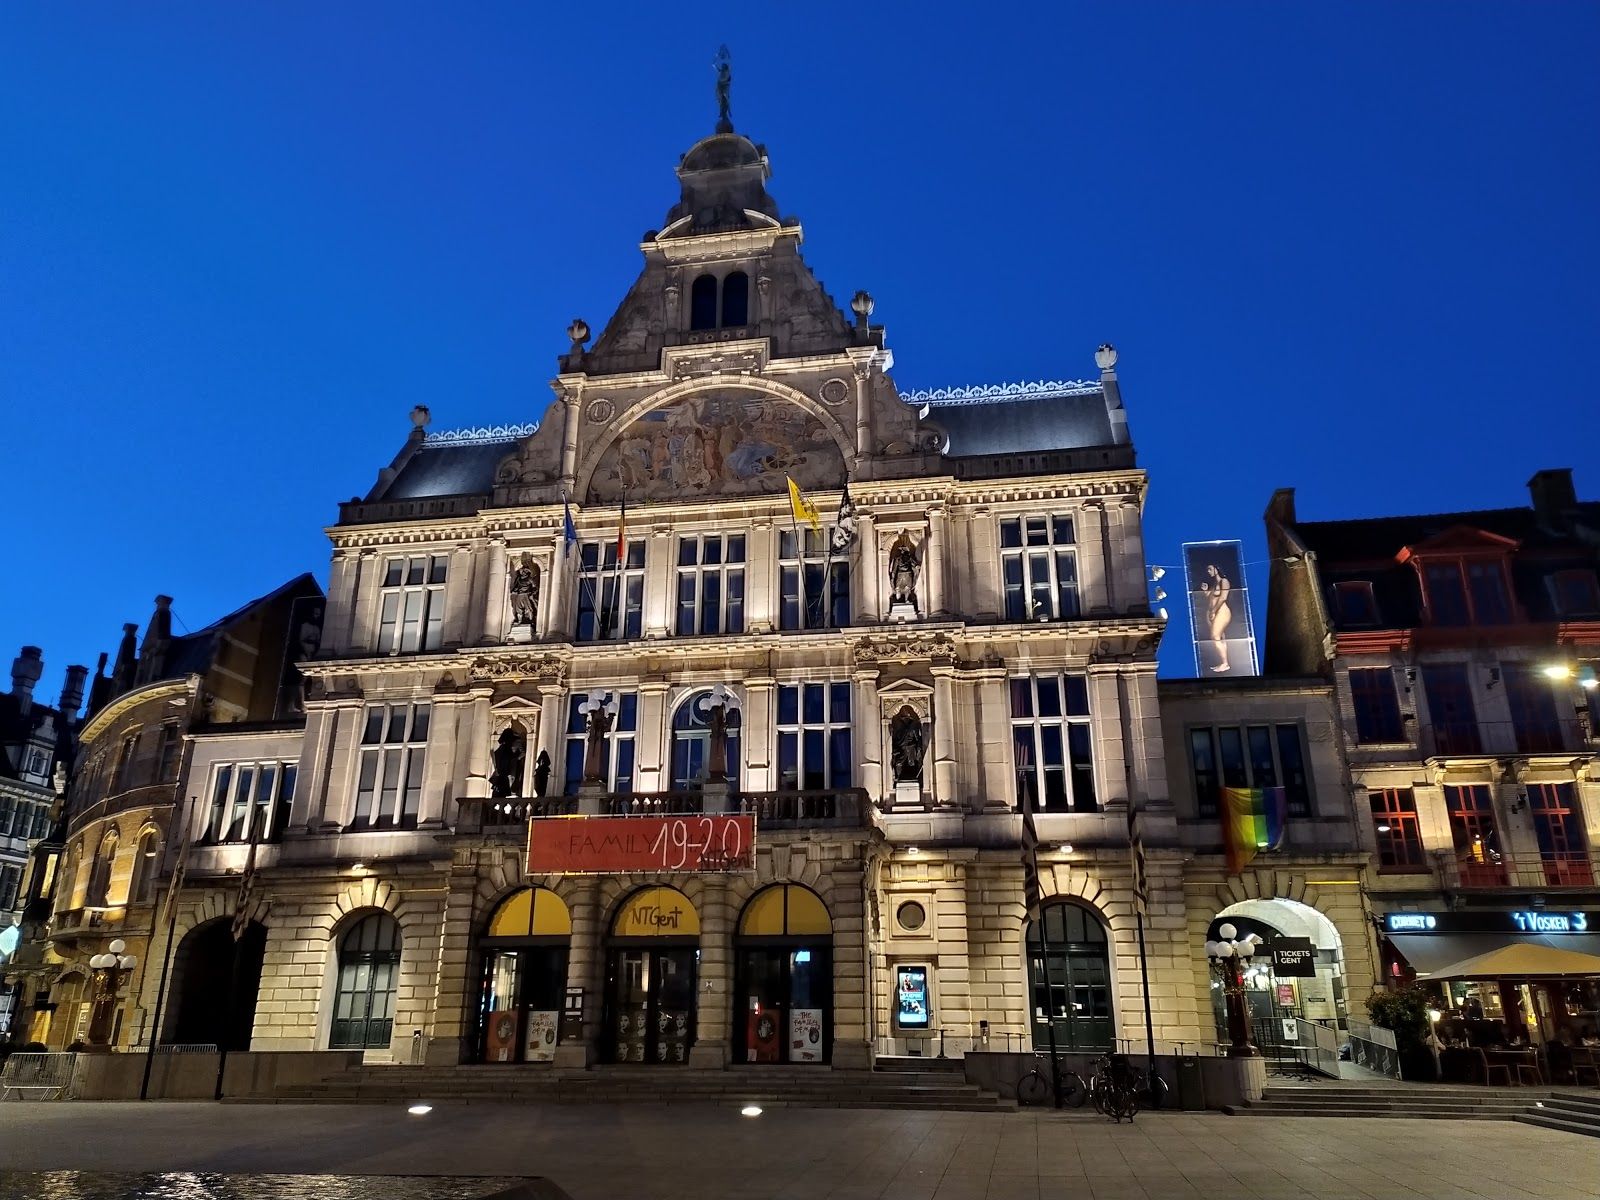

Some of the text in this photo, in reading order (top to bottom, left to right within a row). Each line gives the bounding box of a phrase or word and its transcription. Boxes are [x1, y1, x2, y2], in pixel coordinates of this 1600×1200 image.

[569, 833, 660, 854] FAMILY
[652, 818, 741, 869] 19-20
[632, 906, 683, 929] NTGent
[801, 1011, 812, 1019] THE
